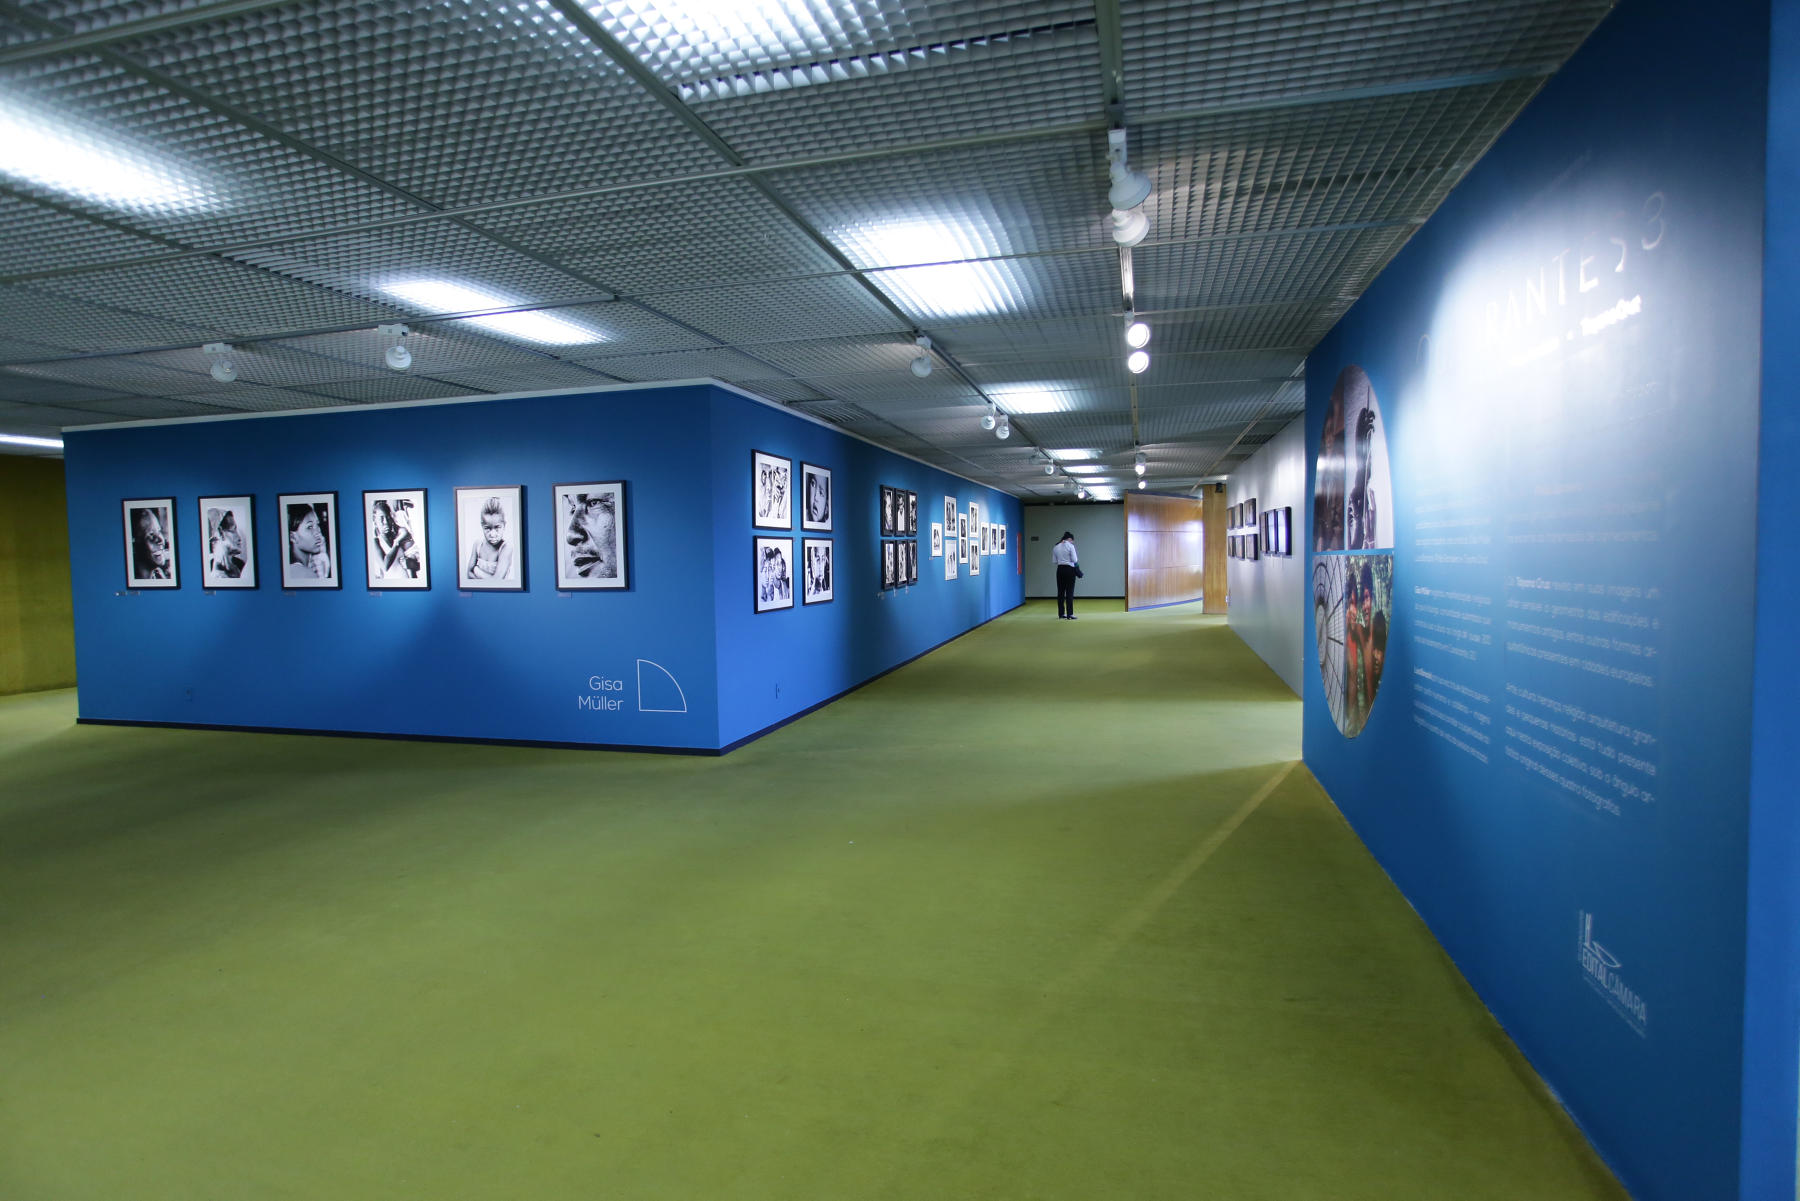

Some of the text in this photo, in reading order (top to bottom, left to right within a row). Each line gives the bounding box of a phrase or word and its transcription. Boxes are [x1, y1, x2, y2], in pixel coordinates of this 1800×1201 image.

[589, 675, 623, 691] Gisa
[578, 695, 624, 711] Müller
[1582, 946, 1607, 989] EDITAL
